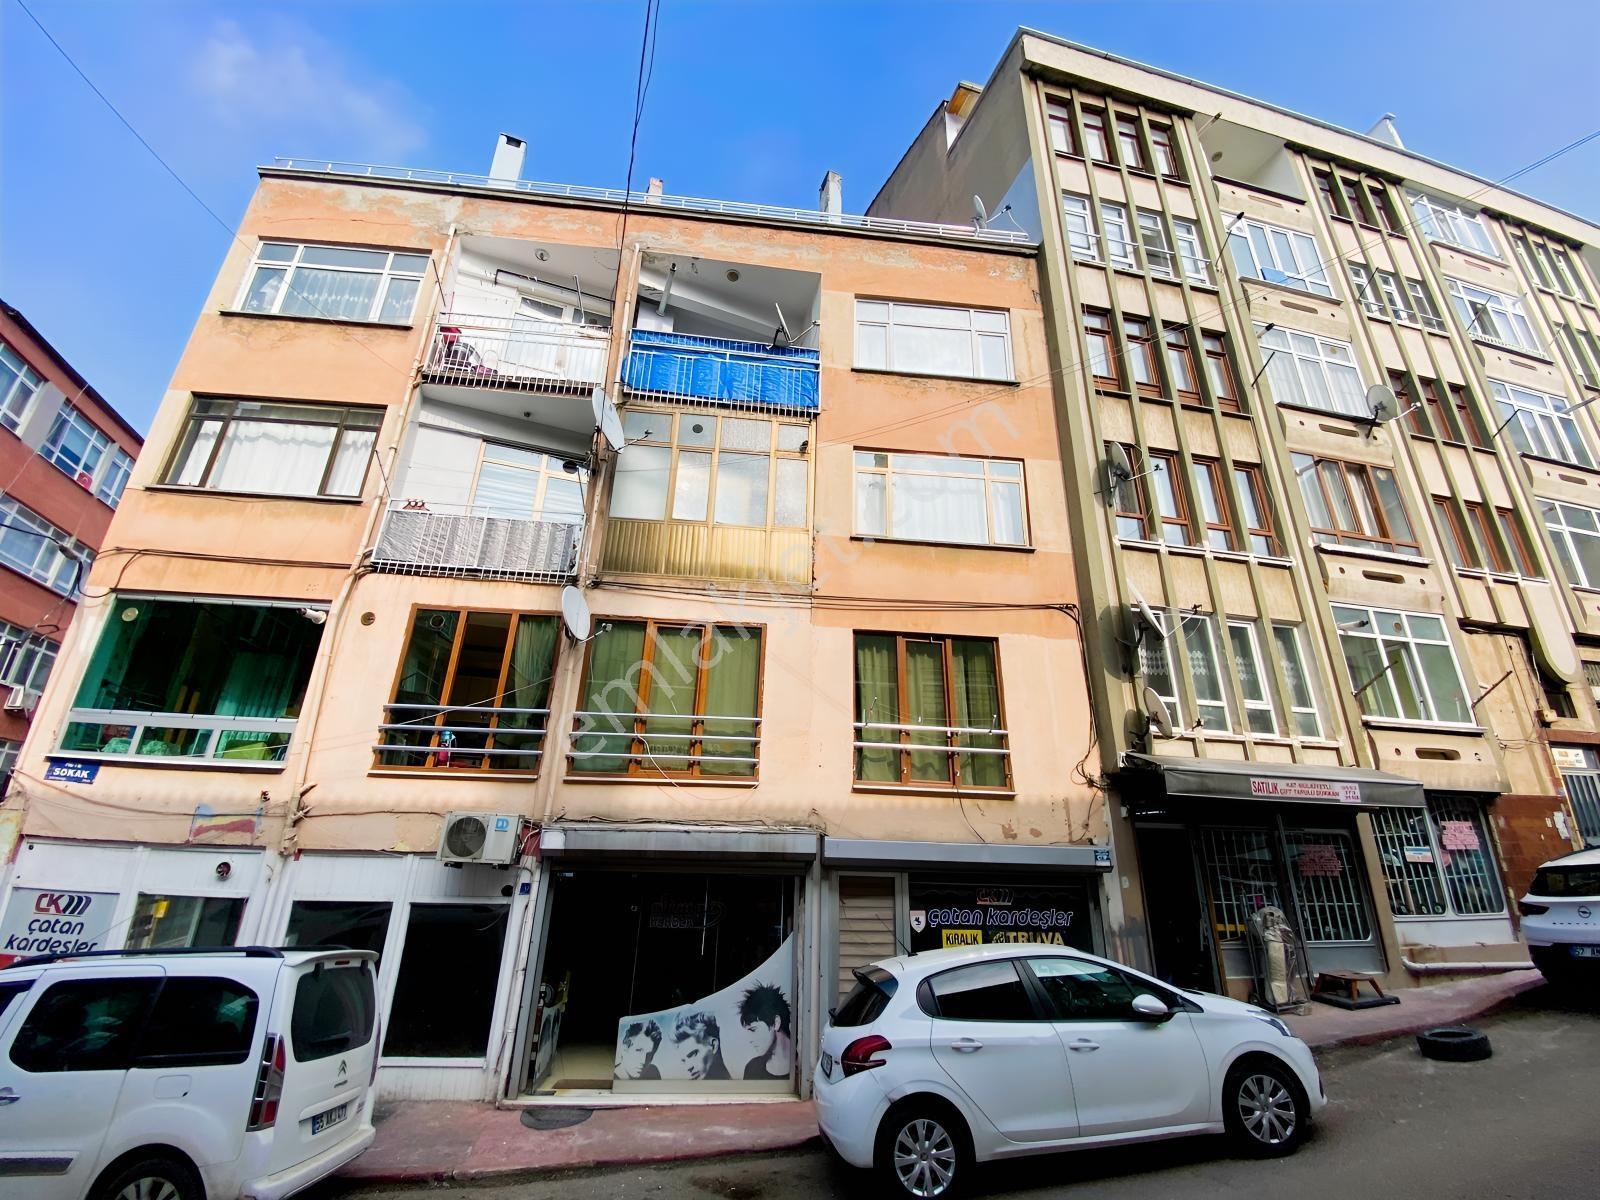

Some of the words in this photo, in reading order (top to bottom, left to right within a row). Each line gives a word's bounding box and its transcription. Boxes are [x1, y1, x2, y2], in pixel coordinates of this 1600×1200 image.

[53, 768, 90, 778] SOKAK
[1252, 781, 1280, 795] SATILIK
[928, 907, 983, 927] çatan
[986, 907, 1073, 928] kardeşler
[28, 918, 85, 936] çatan
[1006, 932, 1064, 945] TRUVA
